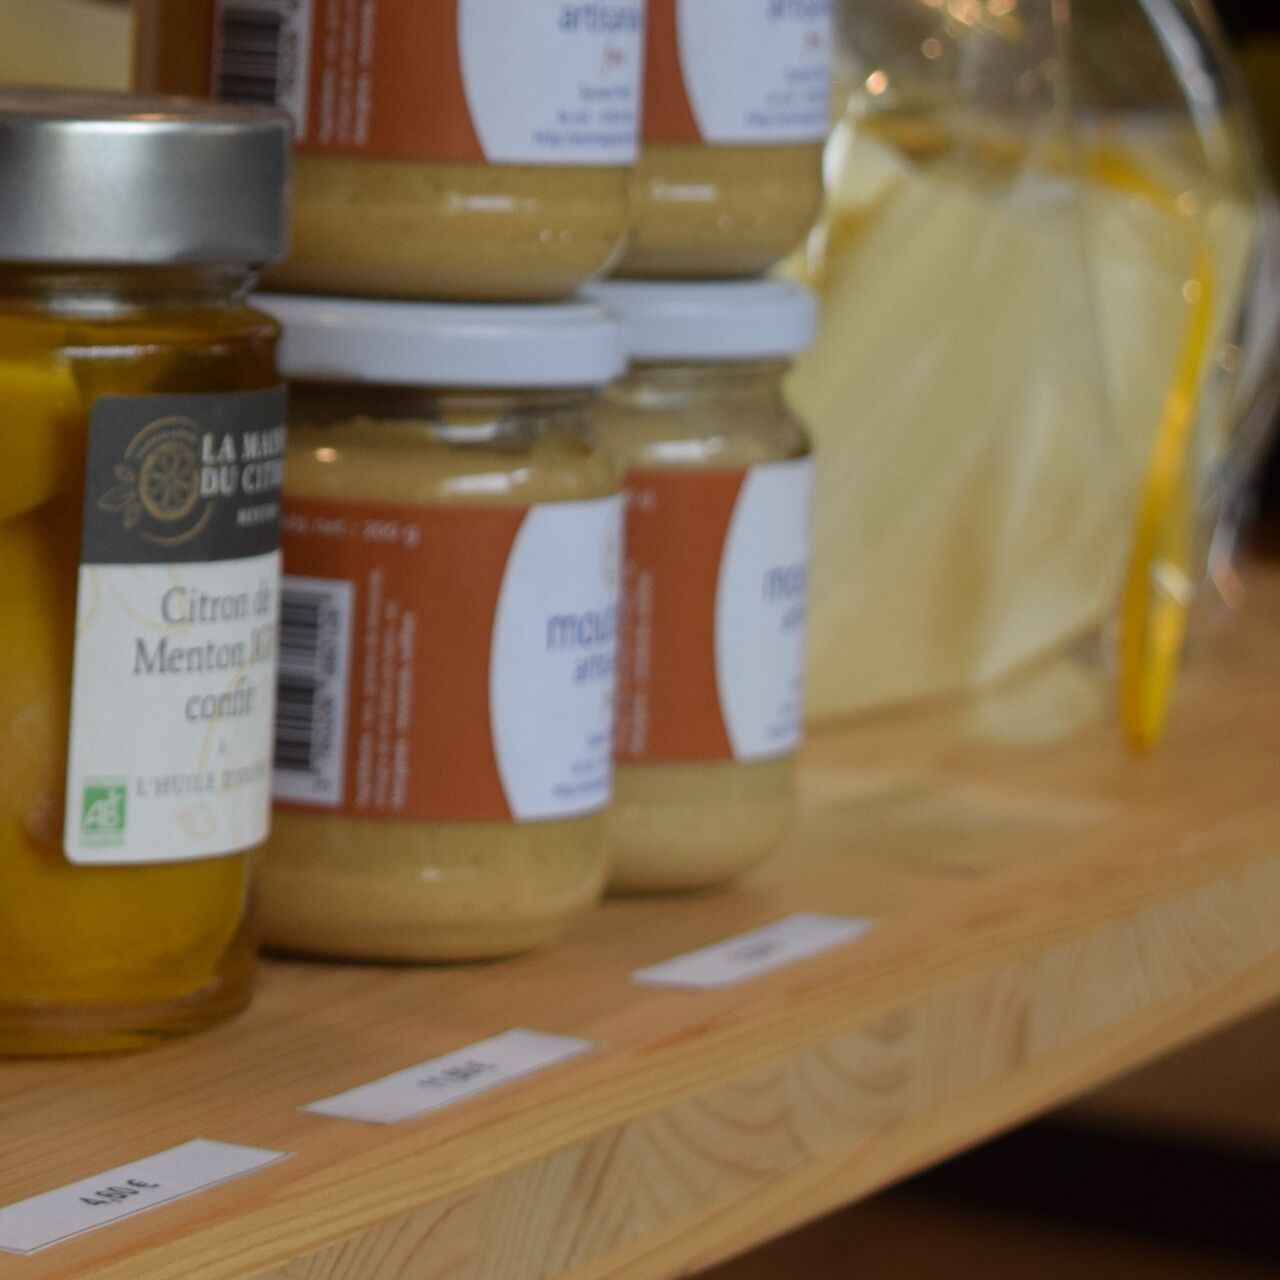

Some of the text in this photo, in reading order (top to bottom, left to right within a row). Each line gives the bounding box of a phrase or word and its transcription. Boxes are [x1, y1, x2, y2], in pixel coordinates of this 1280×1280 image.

[201, 433, 237, 461] LA
[201, 464, 238, 497] DU
[160, 586, 248, 627] Citron
[133, 636, 245, 674] Menton
[79, 1185, 140, 1206] 4,60
